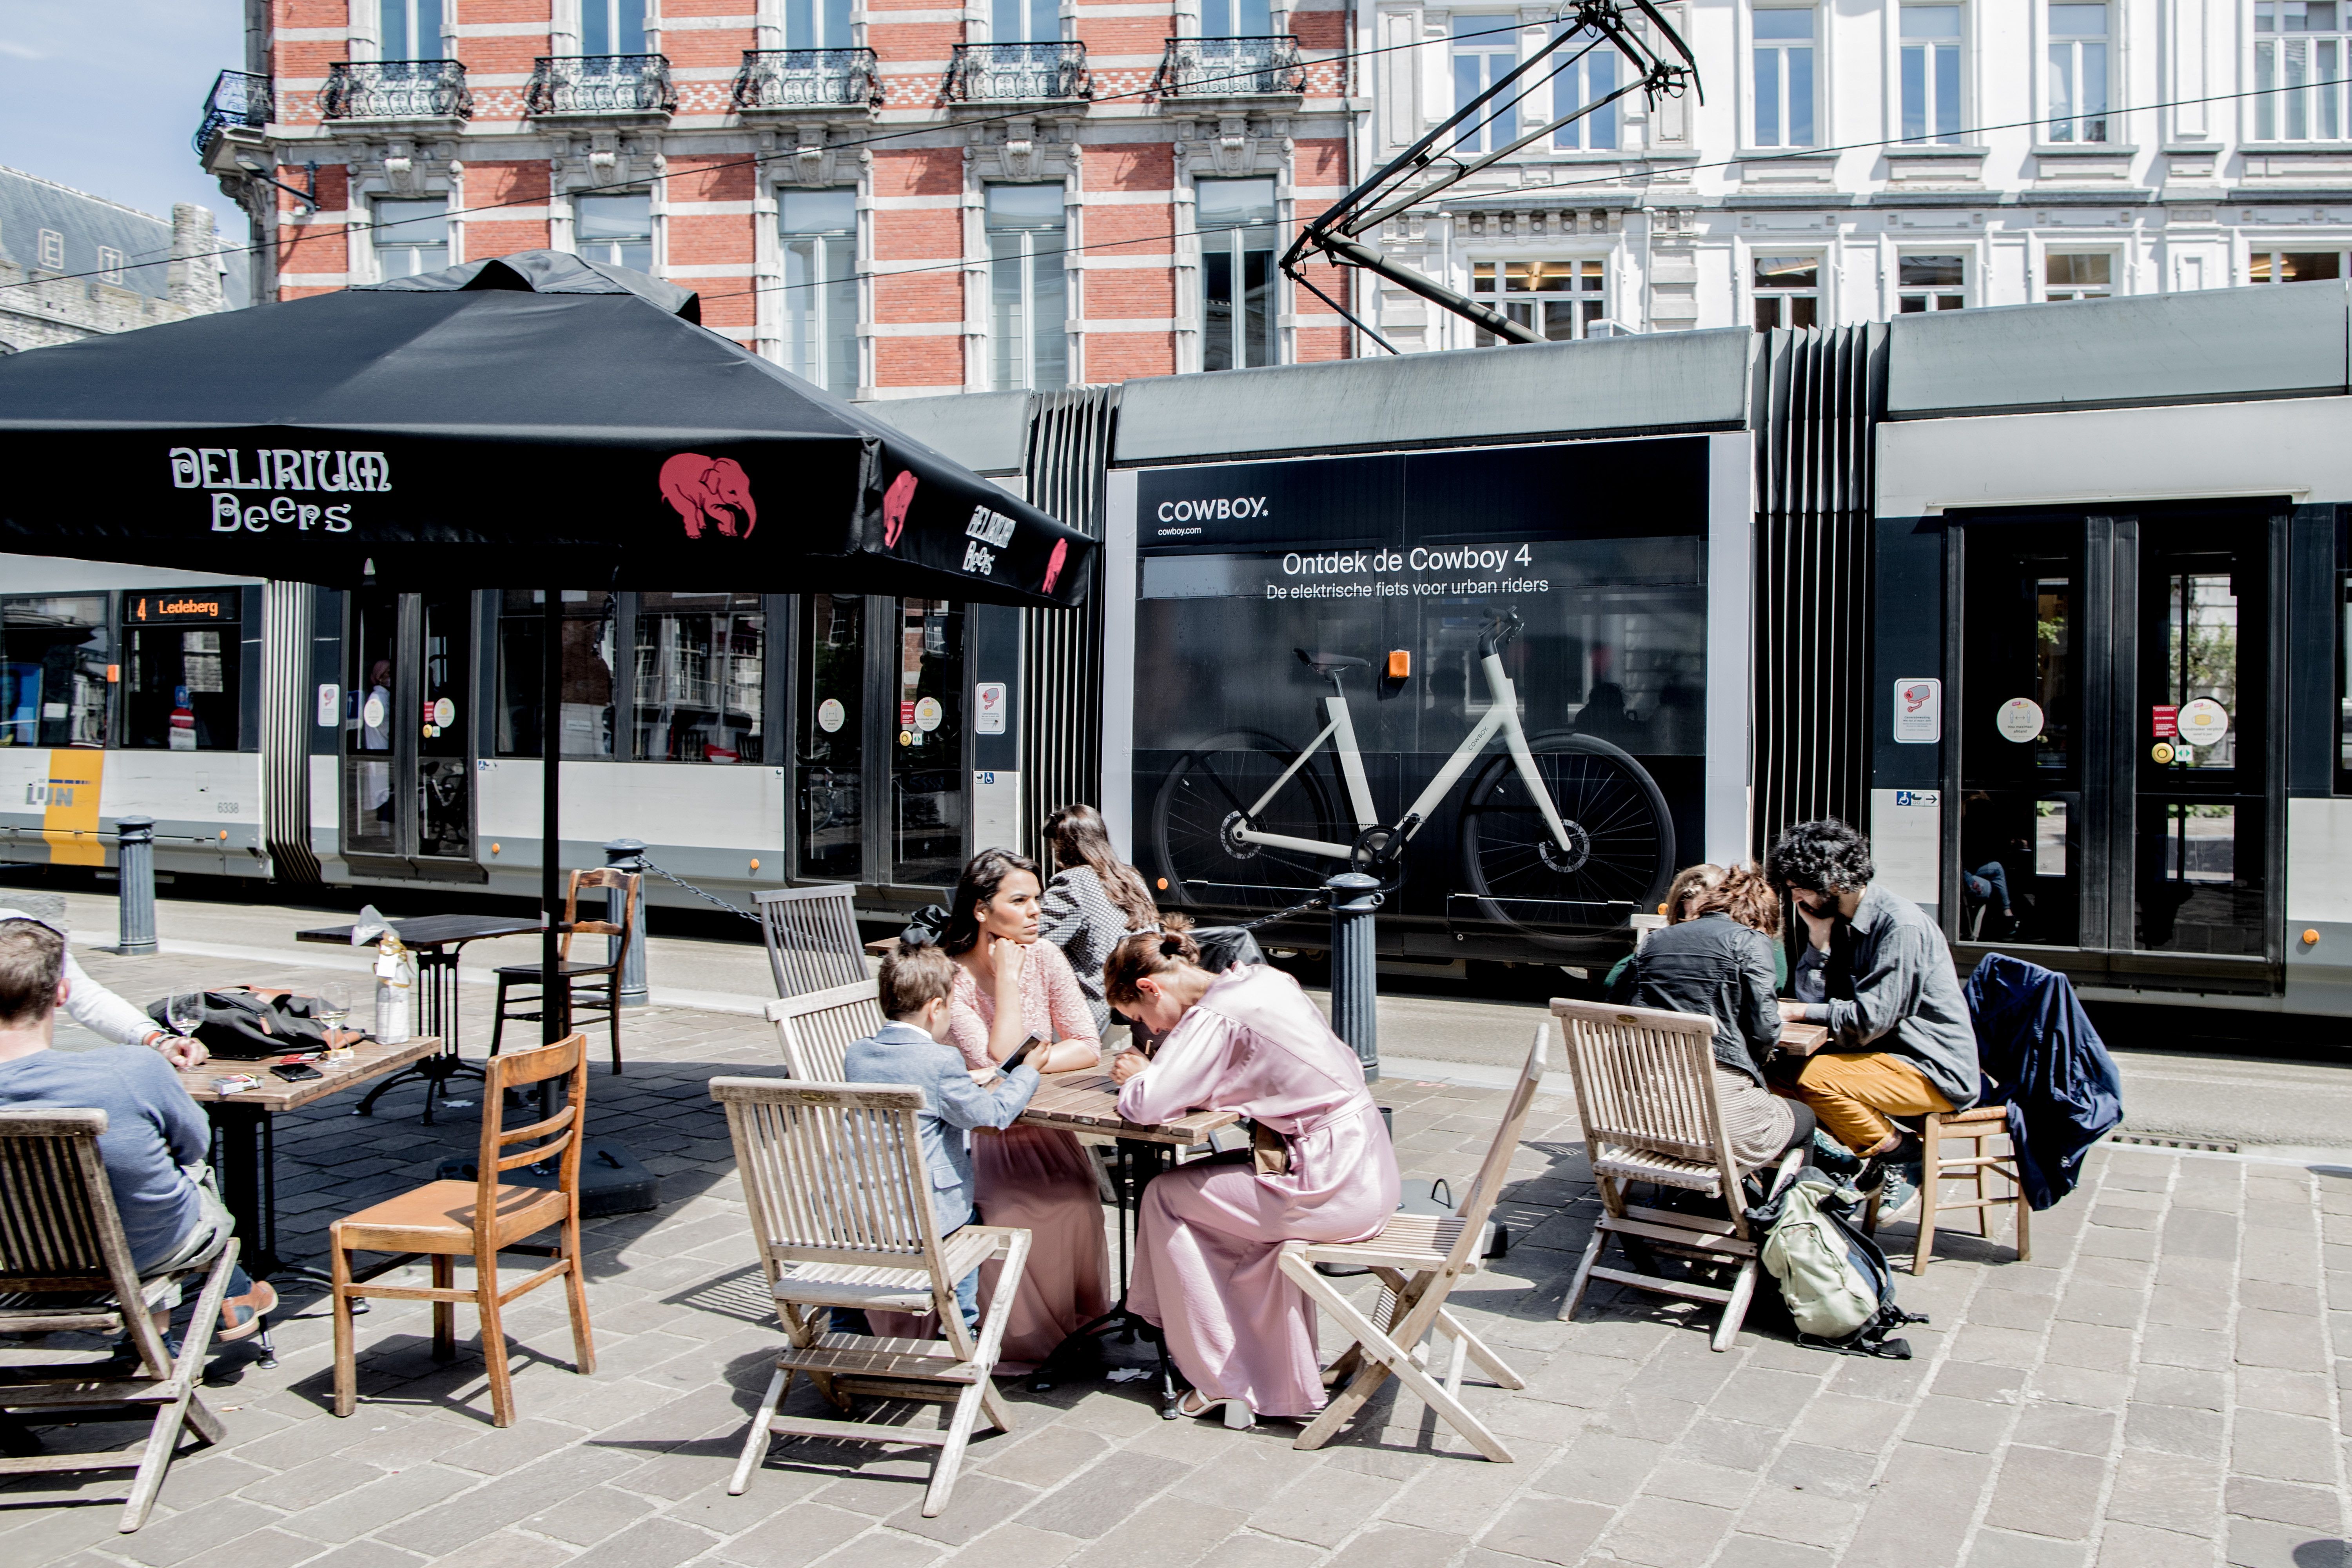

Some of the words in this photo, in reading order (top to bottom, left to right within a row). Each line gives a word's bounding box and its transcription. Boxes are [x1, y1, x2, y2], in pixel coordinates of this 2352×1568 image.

[169, 447, 392, 492] DELIRIUM
[211, 493, 352, 532] Beers
[1158, 528, 1202, 536] cowboy.com
[962, 541, 996, 575] Beers
[1283, 551, 1367, 575] Ontdek
[1373, 548, 1403, 572] de
[1410, 546, 1508, 572] Cowboy
[1514, 544, 1532, 567] 4
[1267, 585, 1287, 599] De
[1291, 583, 1372, 598] elektrische
[1376, 582, 1408, 596] fiets
[1413, 583, 1447, 595] voor
[1452, 579, 1497, 594] urban
[1502, 577, 1549, 593] riders
[137, 598, 146, 621] 4
[159, 599, 218, 616] Ledeberg
[218, 802, 239, 813] 6338
